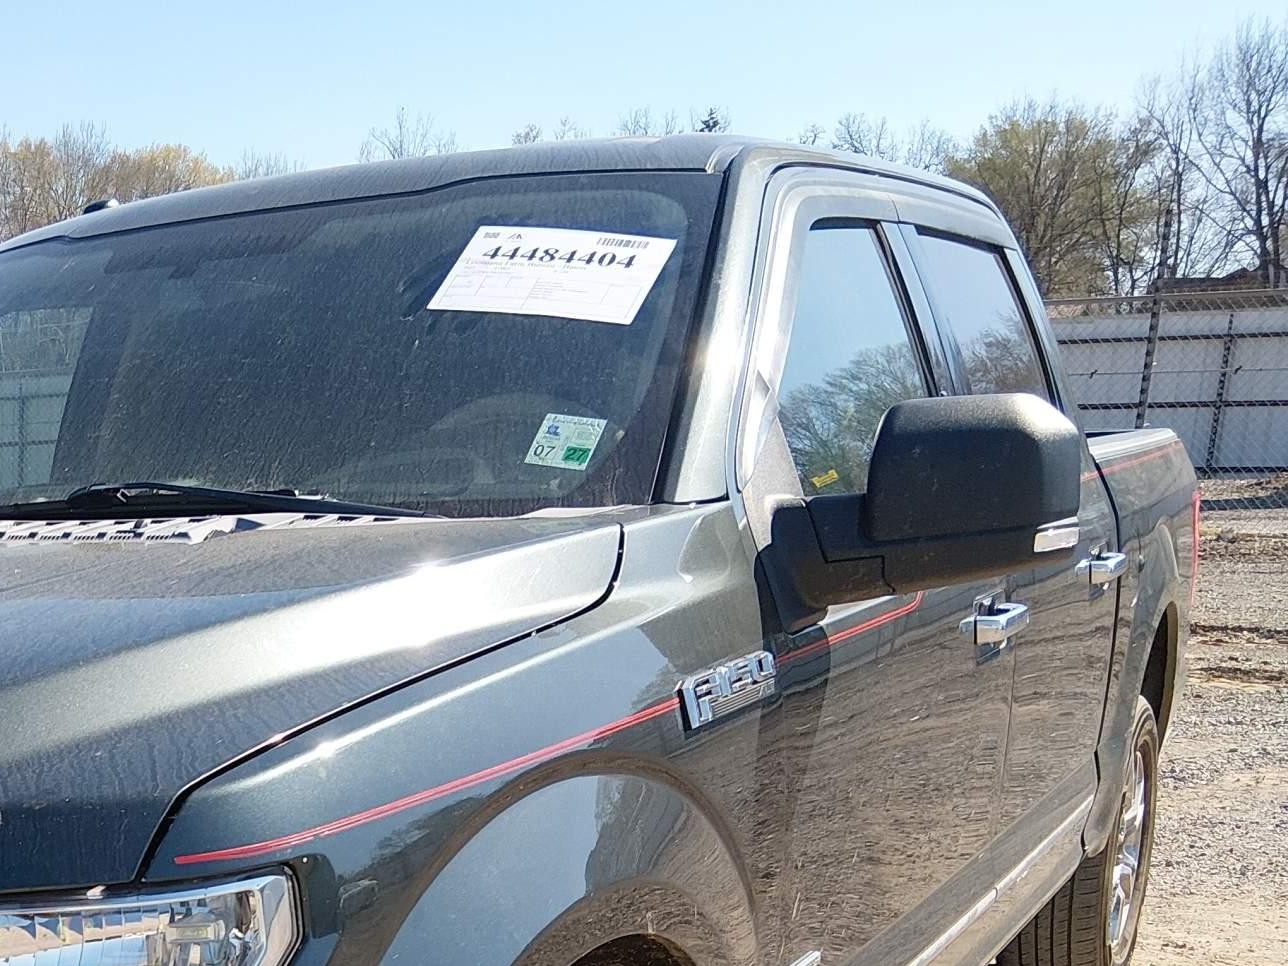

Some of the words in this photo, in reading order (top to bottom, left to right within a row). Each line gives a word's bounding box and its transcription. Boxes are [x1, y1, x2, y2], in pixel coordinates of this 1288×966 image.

[481, 244, 638, 270] 44484404
[533, 444, 556, 457] 07
[564, 447, 587, 464] 27
